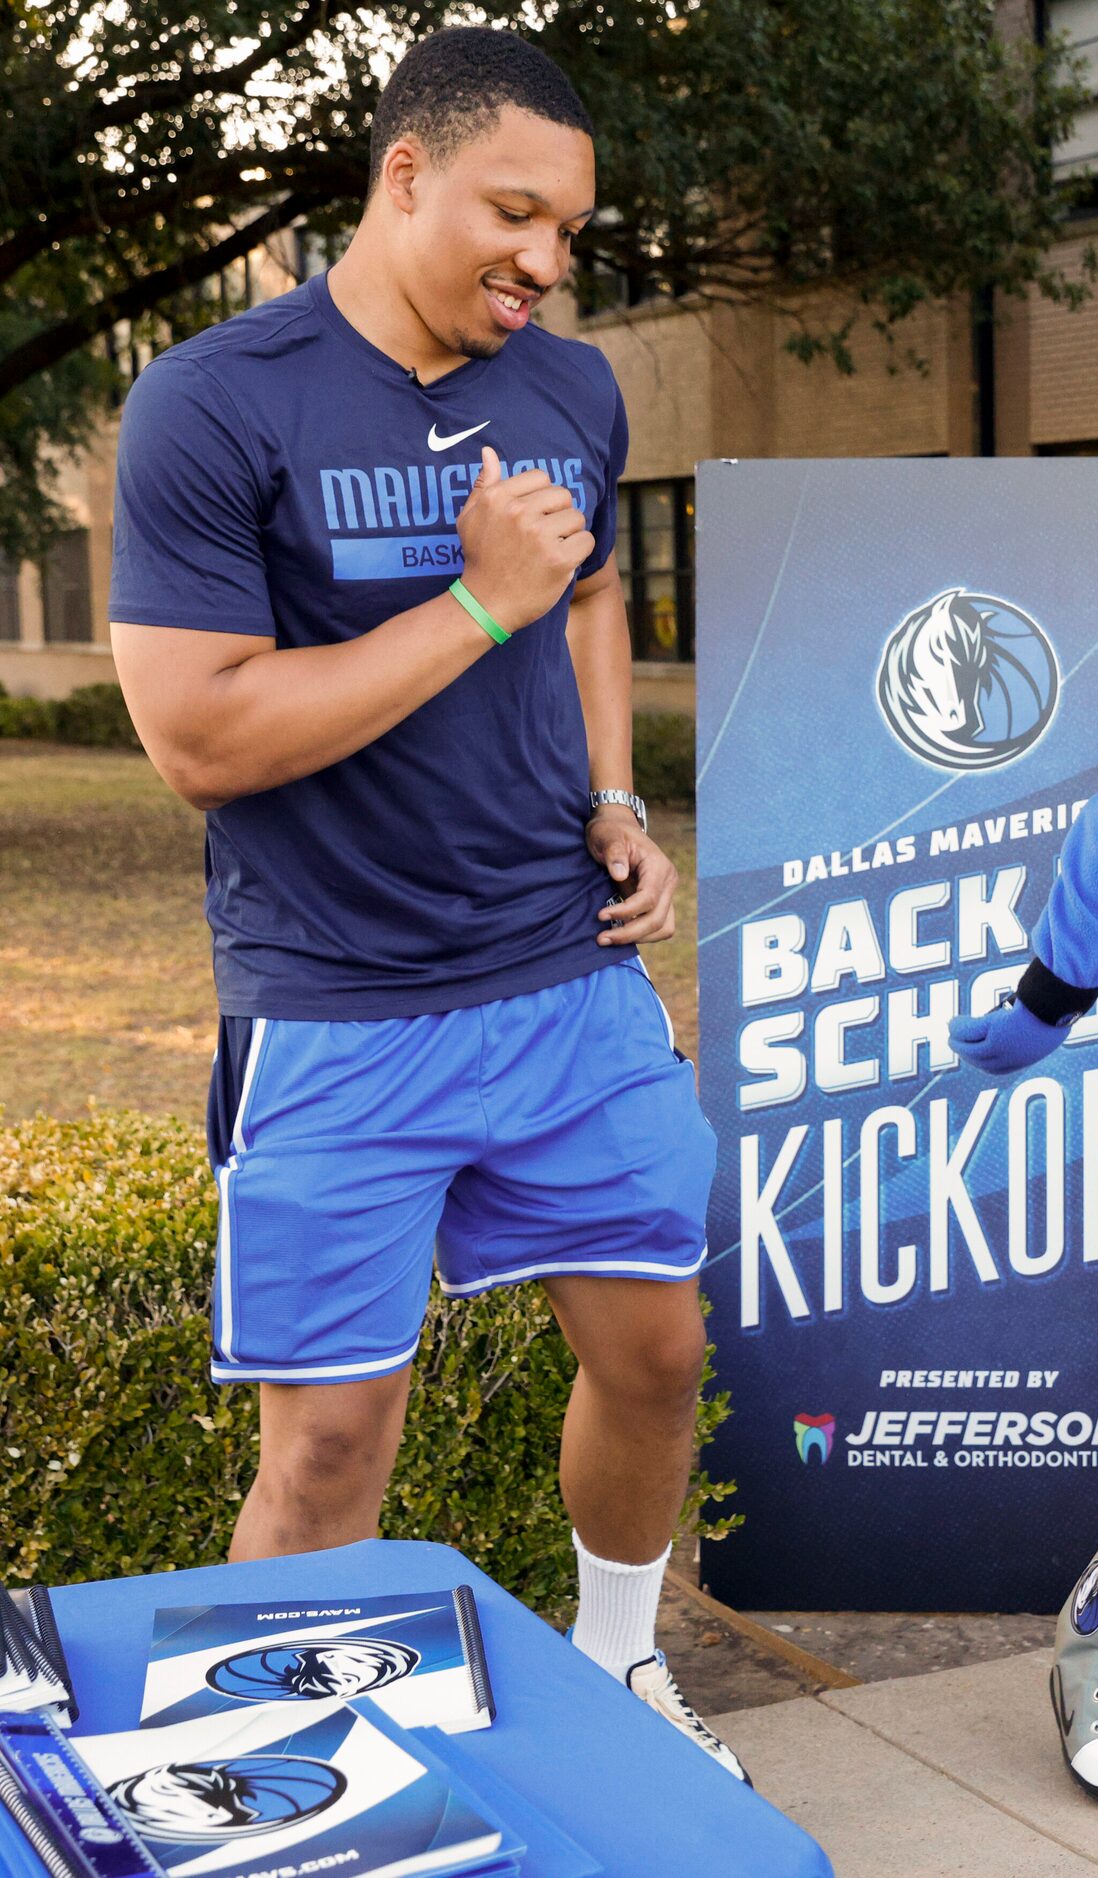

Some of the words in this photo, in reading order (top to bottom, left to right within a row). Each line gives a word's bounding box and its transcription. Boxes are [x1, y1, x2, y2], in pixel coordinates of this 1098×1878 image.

[320, 458, 586, 530] MAVES
[783, 836, 916, 887] DALLAS
[741, 865, 1027, 1008] BACK
[879, 1369, 1020, 1388] PRESENTED
[1026, 1370, 1059, 1388] BY
[847, 1450, 928, 1468] DENTAL
[933, 1450, 949, 1468] &
[256, 1606, 361, 1621] MAVS.COM
